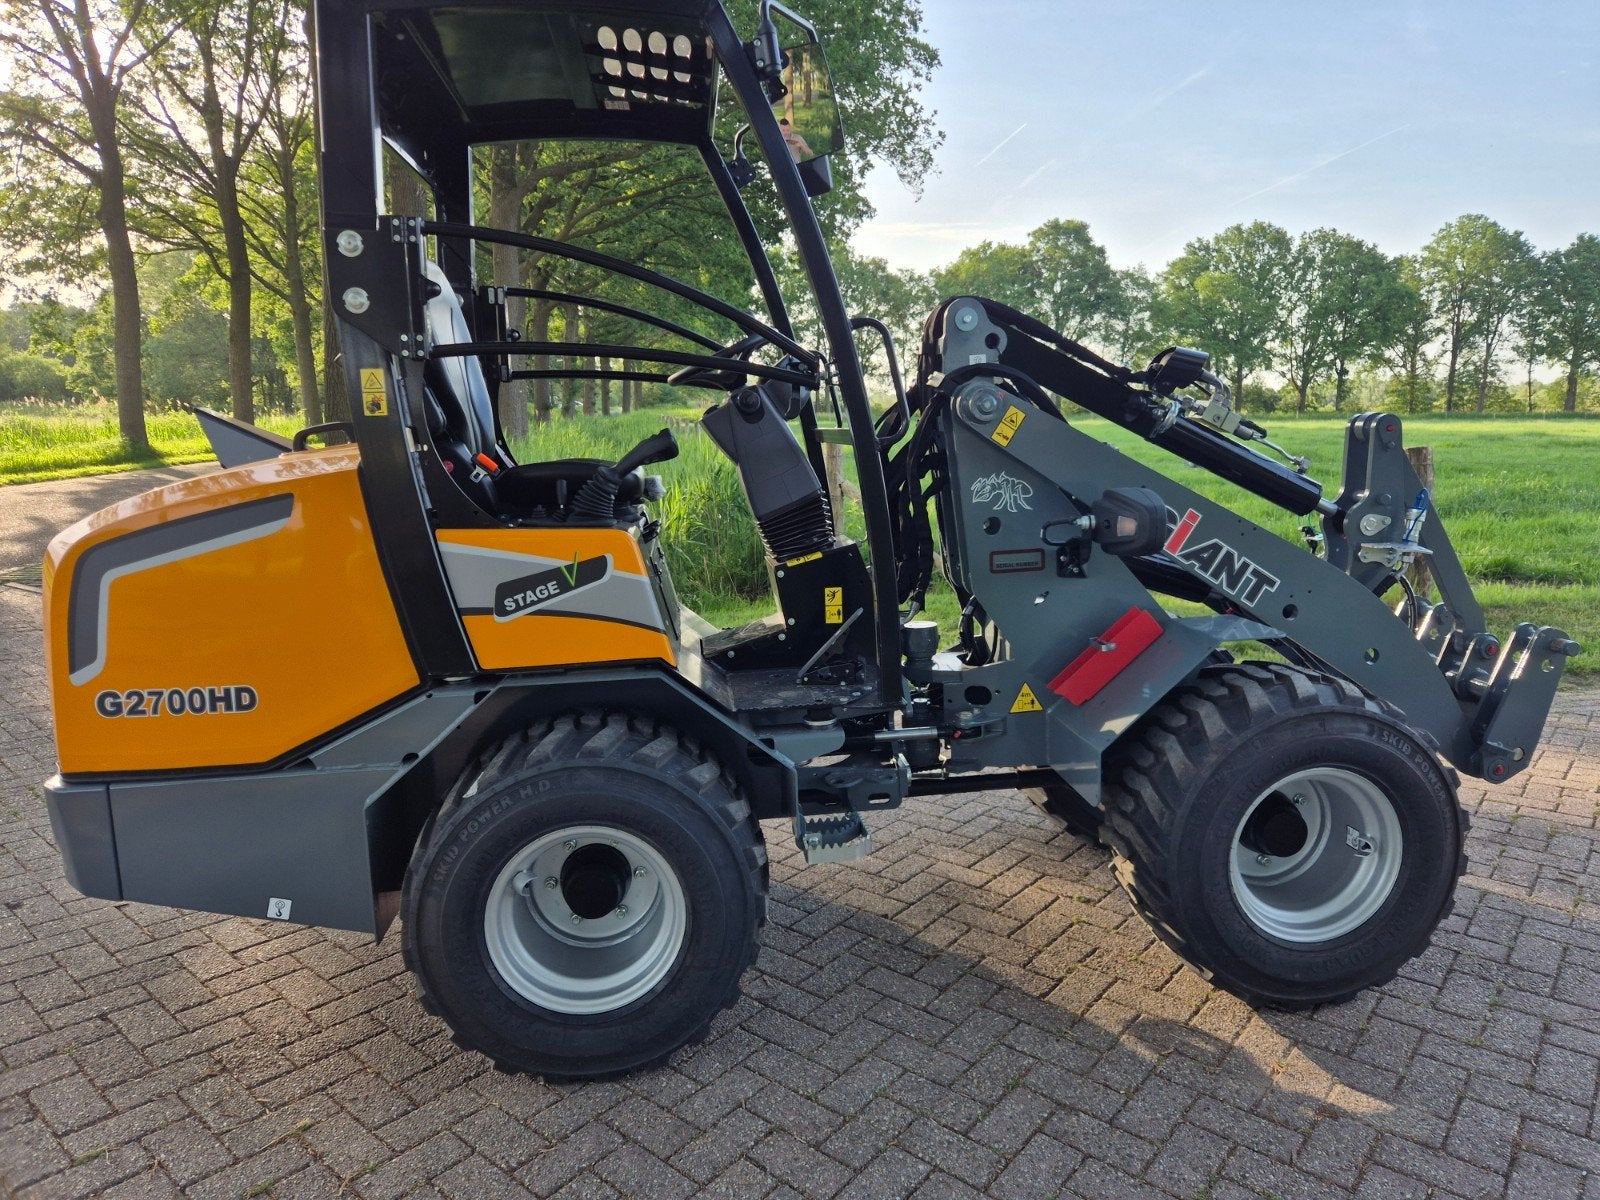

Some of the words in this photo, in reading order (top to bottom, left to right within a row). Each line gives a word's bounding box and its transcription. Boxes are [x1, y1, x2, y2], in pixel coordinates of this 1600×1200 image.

[503, 580, 561, 612] STAGE
[560, 550, 580, 588] V
[95, 685, 259, 719] G2700HD
[1381, 729, 1412, 756] SKID
[433, 844, 460, 882] SKID
[460, 795, 514, 842] POWER
